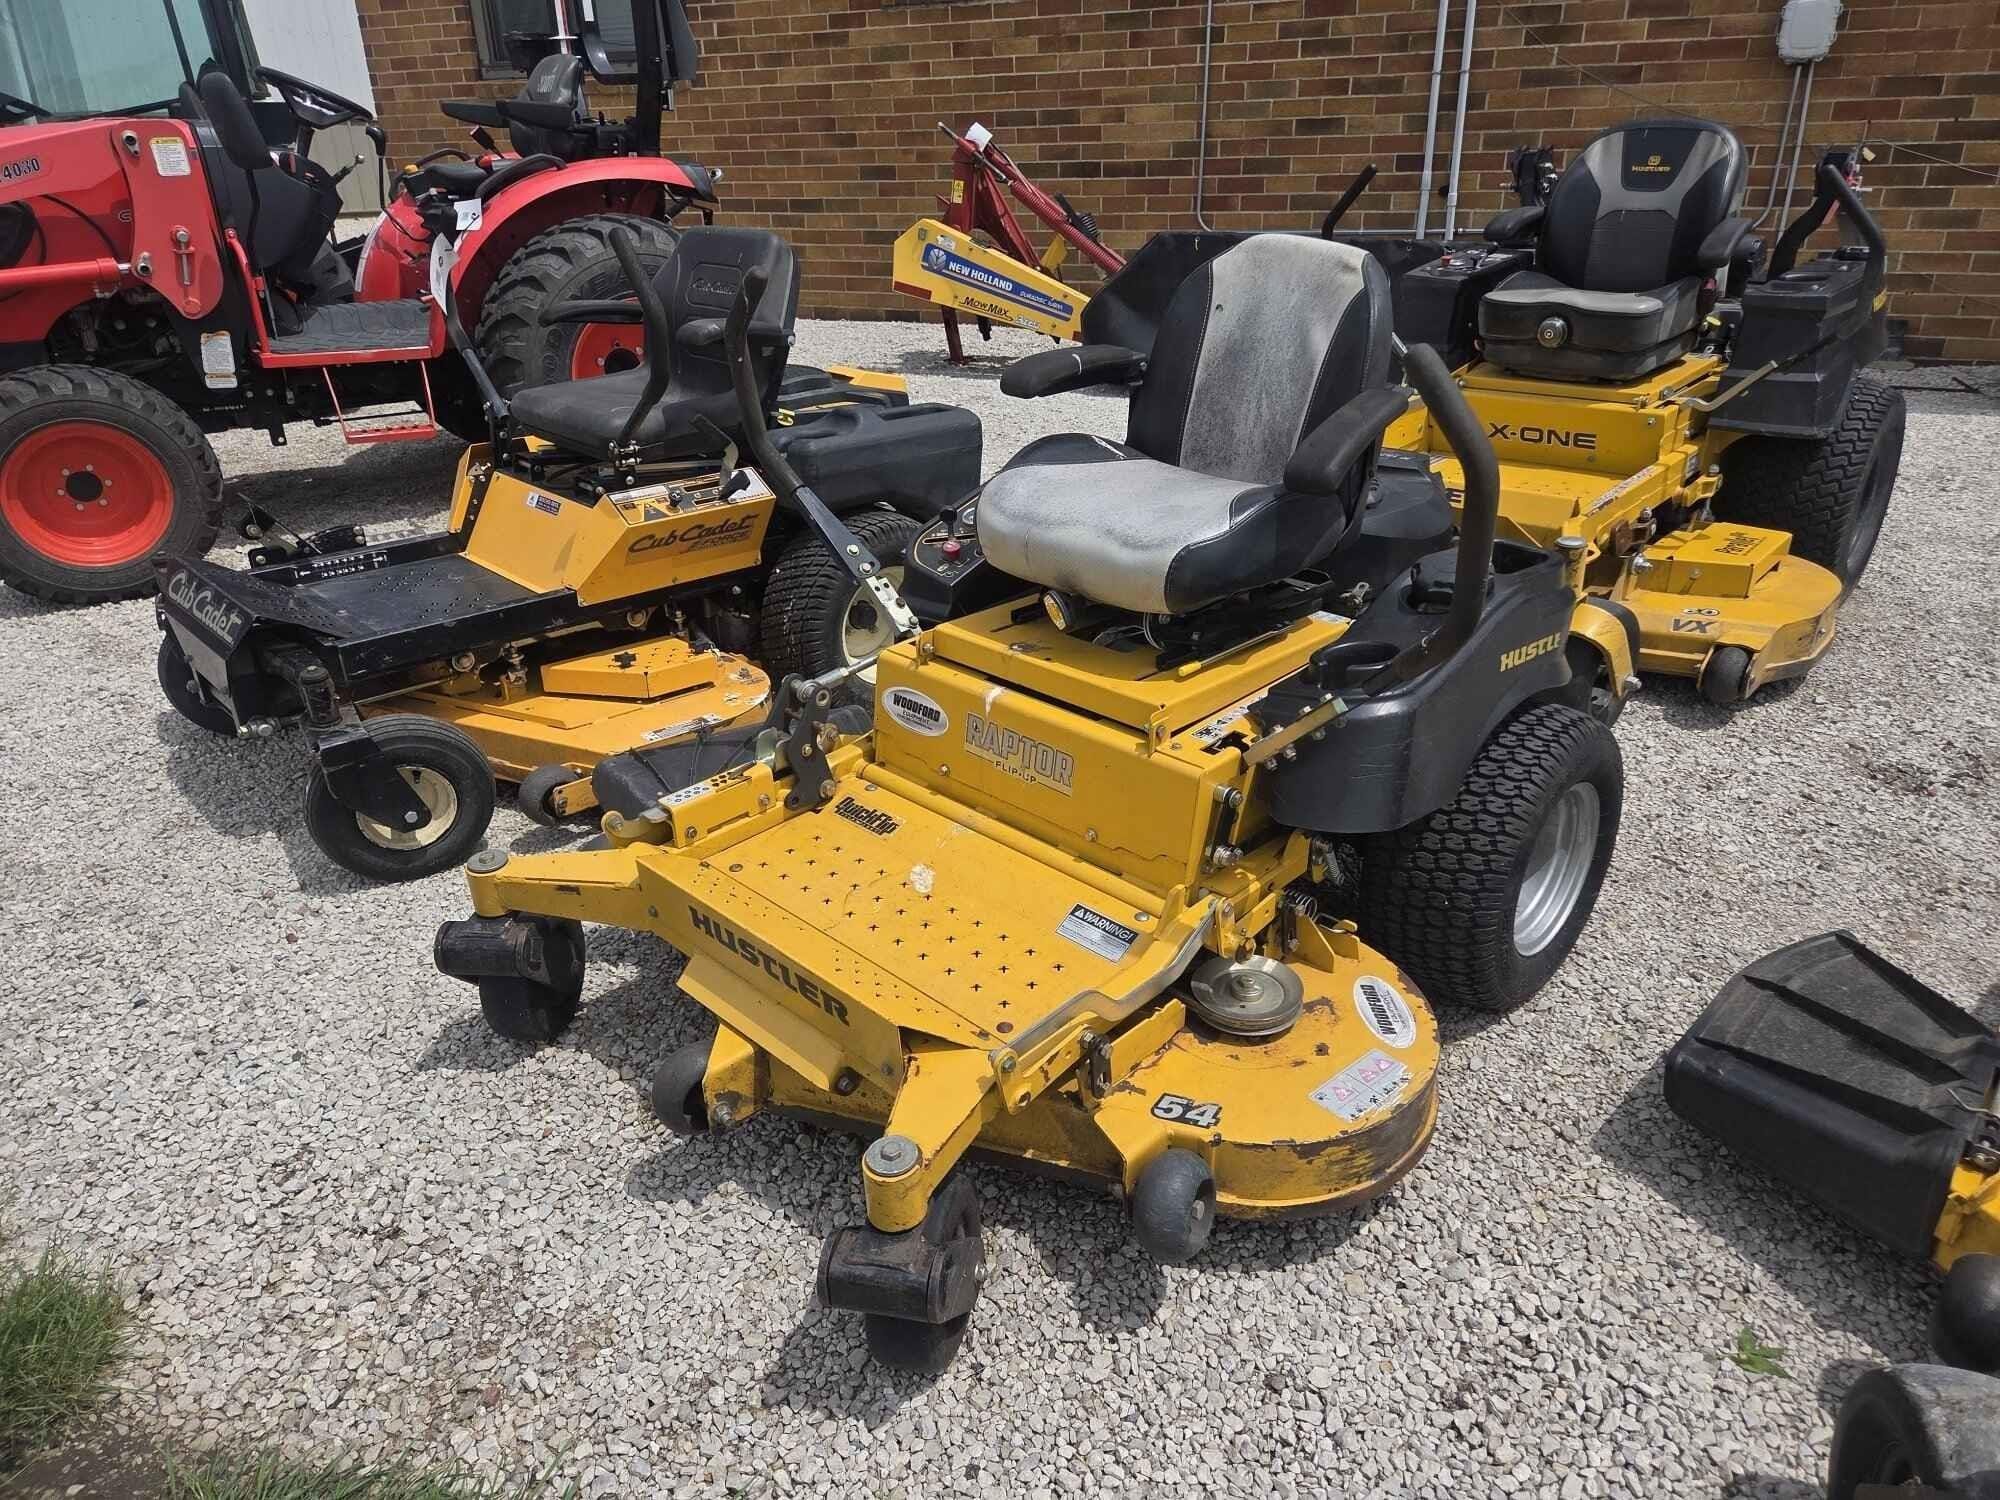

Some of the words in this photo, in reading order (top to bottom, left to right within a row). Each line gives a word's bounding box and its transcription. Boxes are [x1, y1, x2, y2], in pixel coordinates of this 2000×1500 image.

[0, 158, 40, 182] 4030
[948, 261, 971, 276] NEW
[970, 269, 1013, 291] HOLLAND
[961, 297, 1009, 317] MowMax
[1488, 423, 1596, 449] X-ONE
[628, 529, 677, 552] Cub
[679, 514, 758, 541] Cadet
[168, 572, 197, 609] Cub
[193, 591, 241, 643] Cadet
[1672, 618, 1719, 634] VX
[893, 693, 941, 722] WOODFORD
[966, 712, 1074, 788] RAPTOR
[834, 796, 900, 834] QuickFlip
[1083, 911, 1134, 941] WARNING!
[688, 904, 850, 1028] HUSTLER
[1360, 984, 1397, 1035] WOODFORD
[1152, 1093, 1220, 1127] 54
